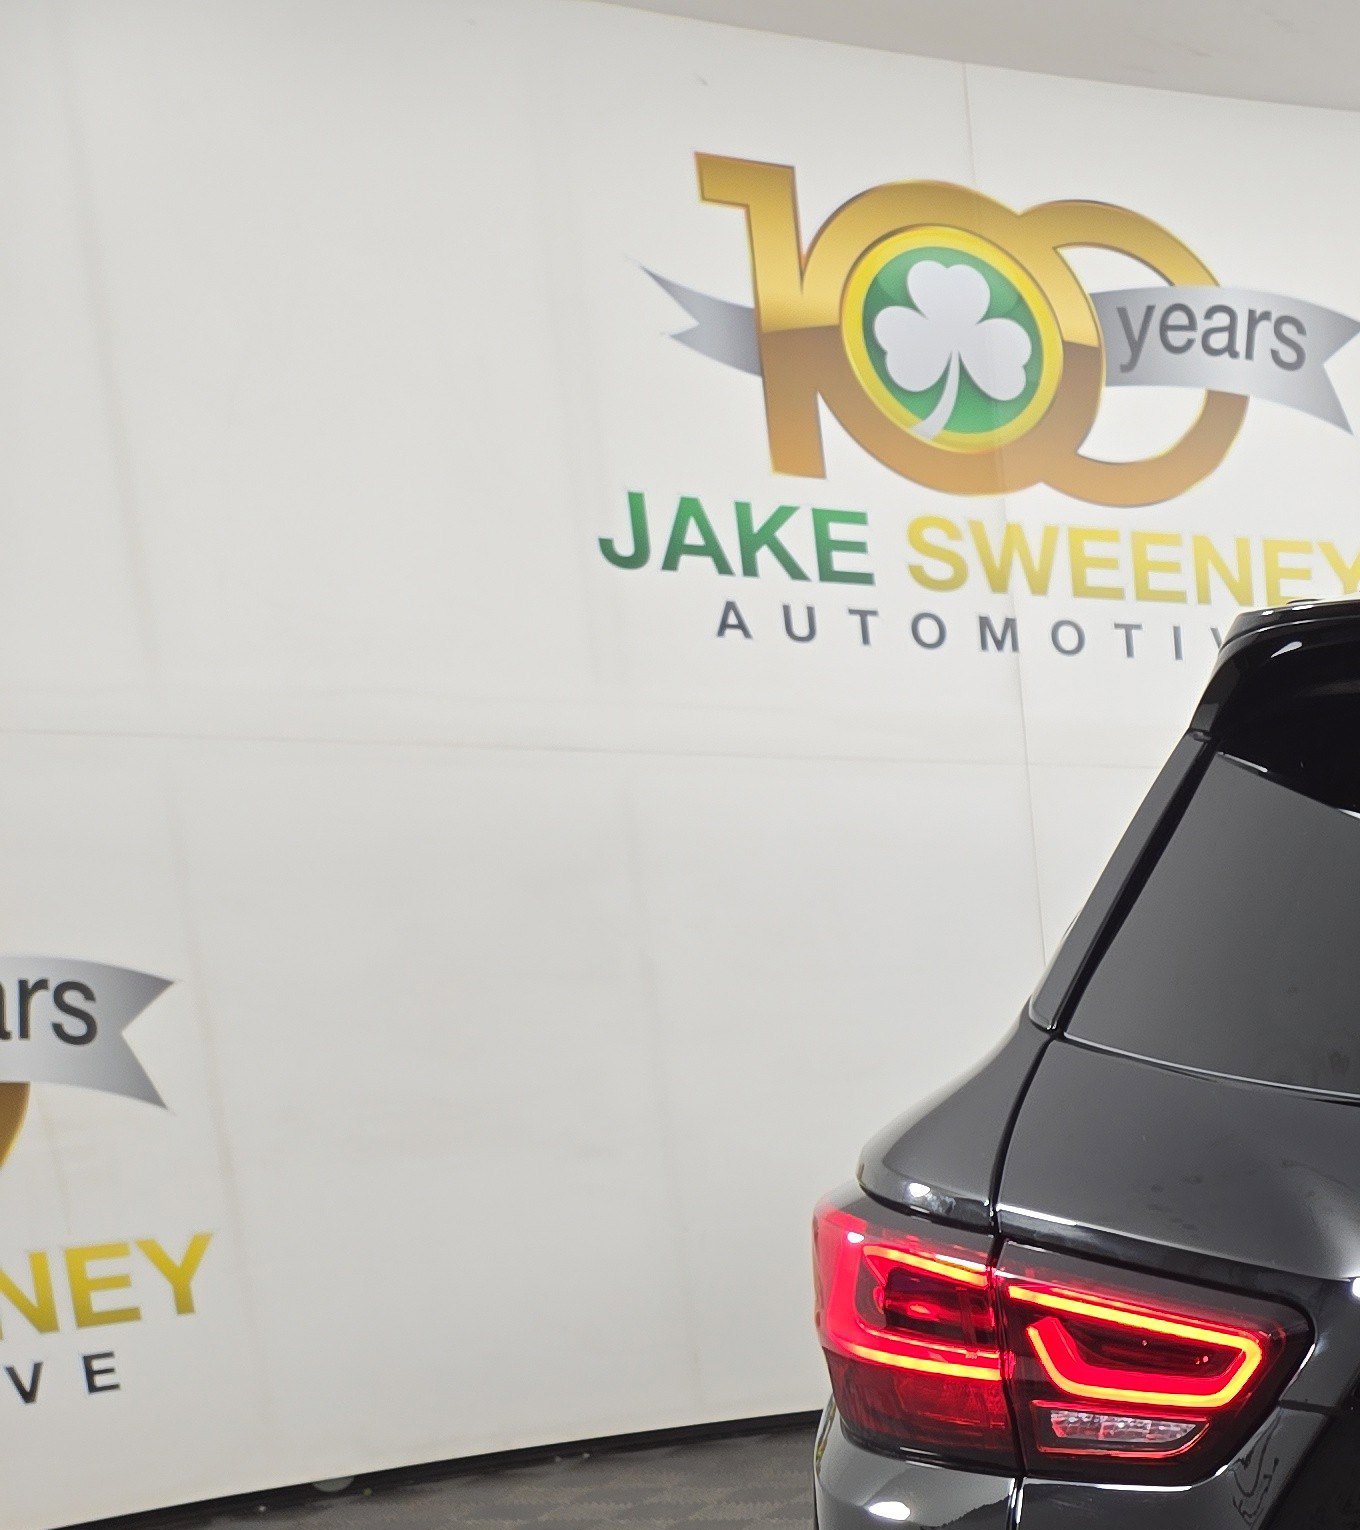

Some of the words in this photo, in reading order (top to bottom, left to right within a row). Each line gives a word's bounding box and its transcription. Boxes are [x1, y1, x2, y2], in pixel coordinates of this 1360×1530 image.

[694, 150, 1250, 507] 100
[1117, 302, 1308, 373] years
[598, 490, 875, 587] JAKE
